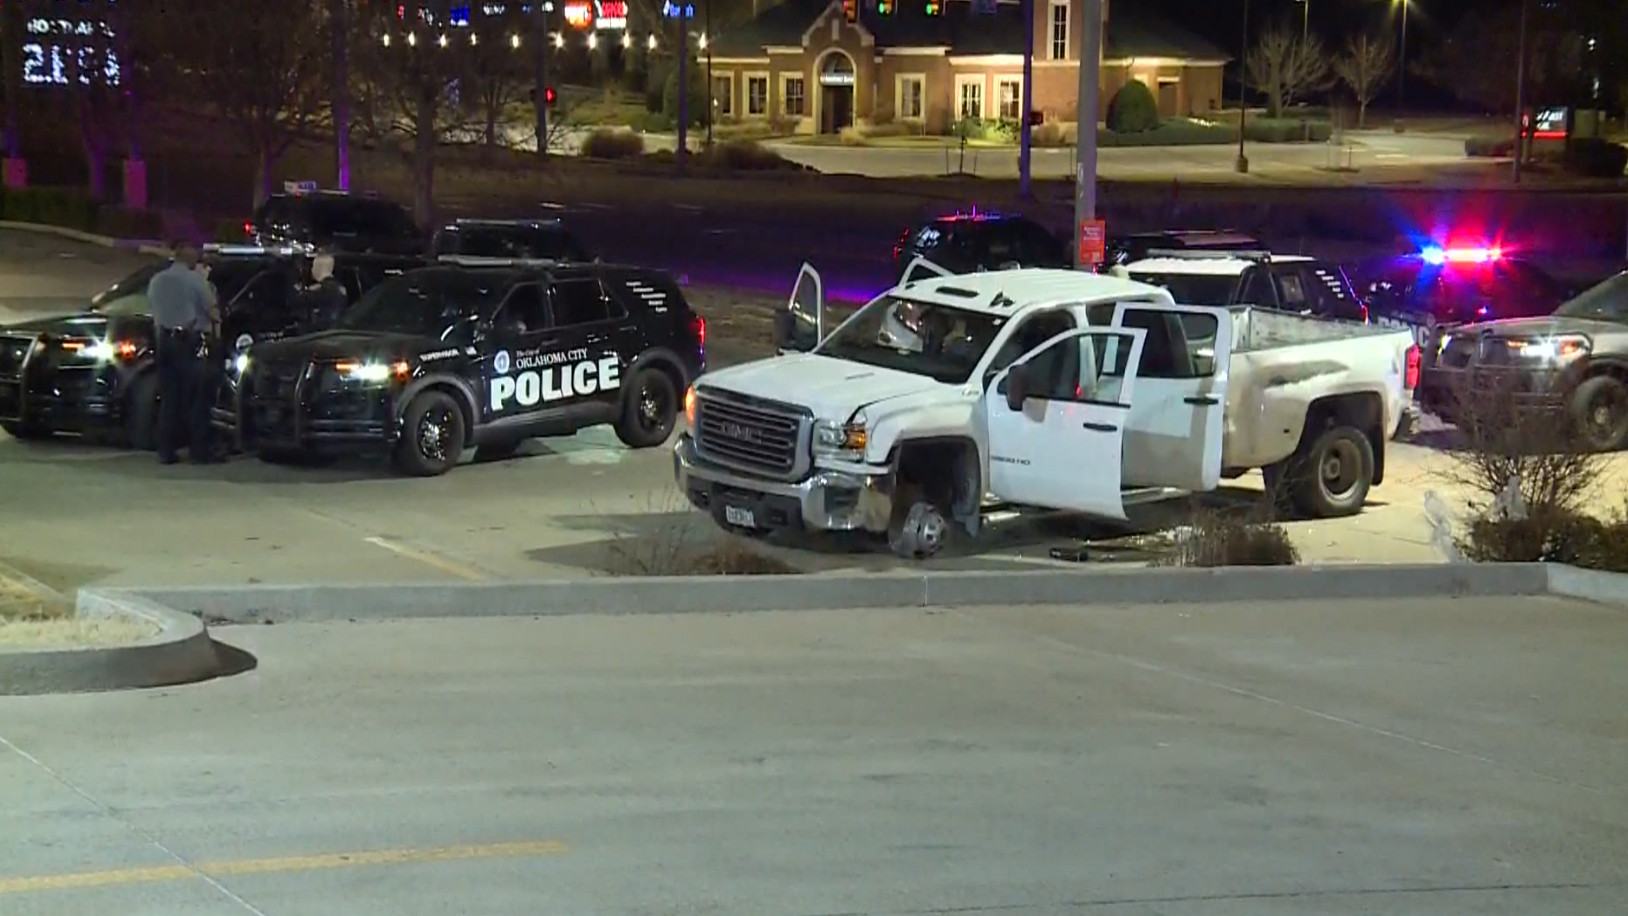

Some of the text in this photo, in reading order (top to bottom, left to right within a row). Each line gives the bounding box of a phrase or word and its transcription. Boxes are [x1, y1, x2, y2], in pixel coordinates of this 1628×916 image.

[516, 348, 588, 369] OKLAHOMA CITY
[491, 356, 620, 411] POLICE
